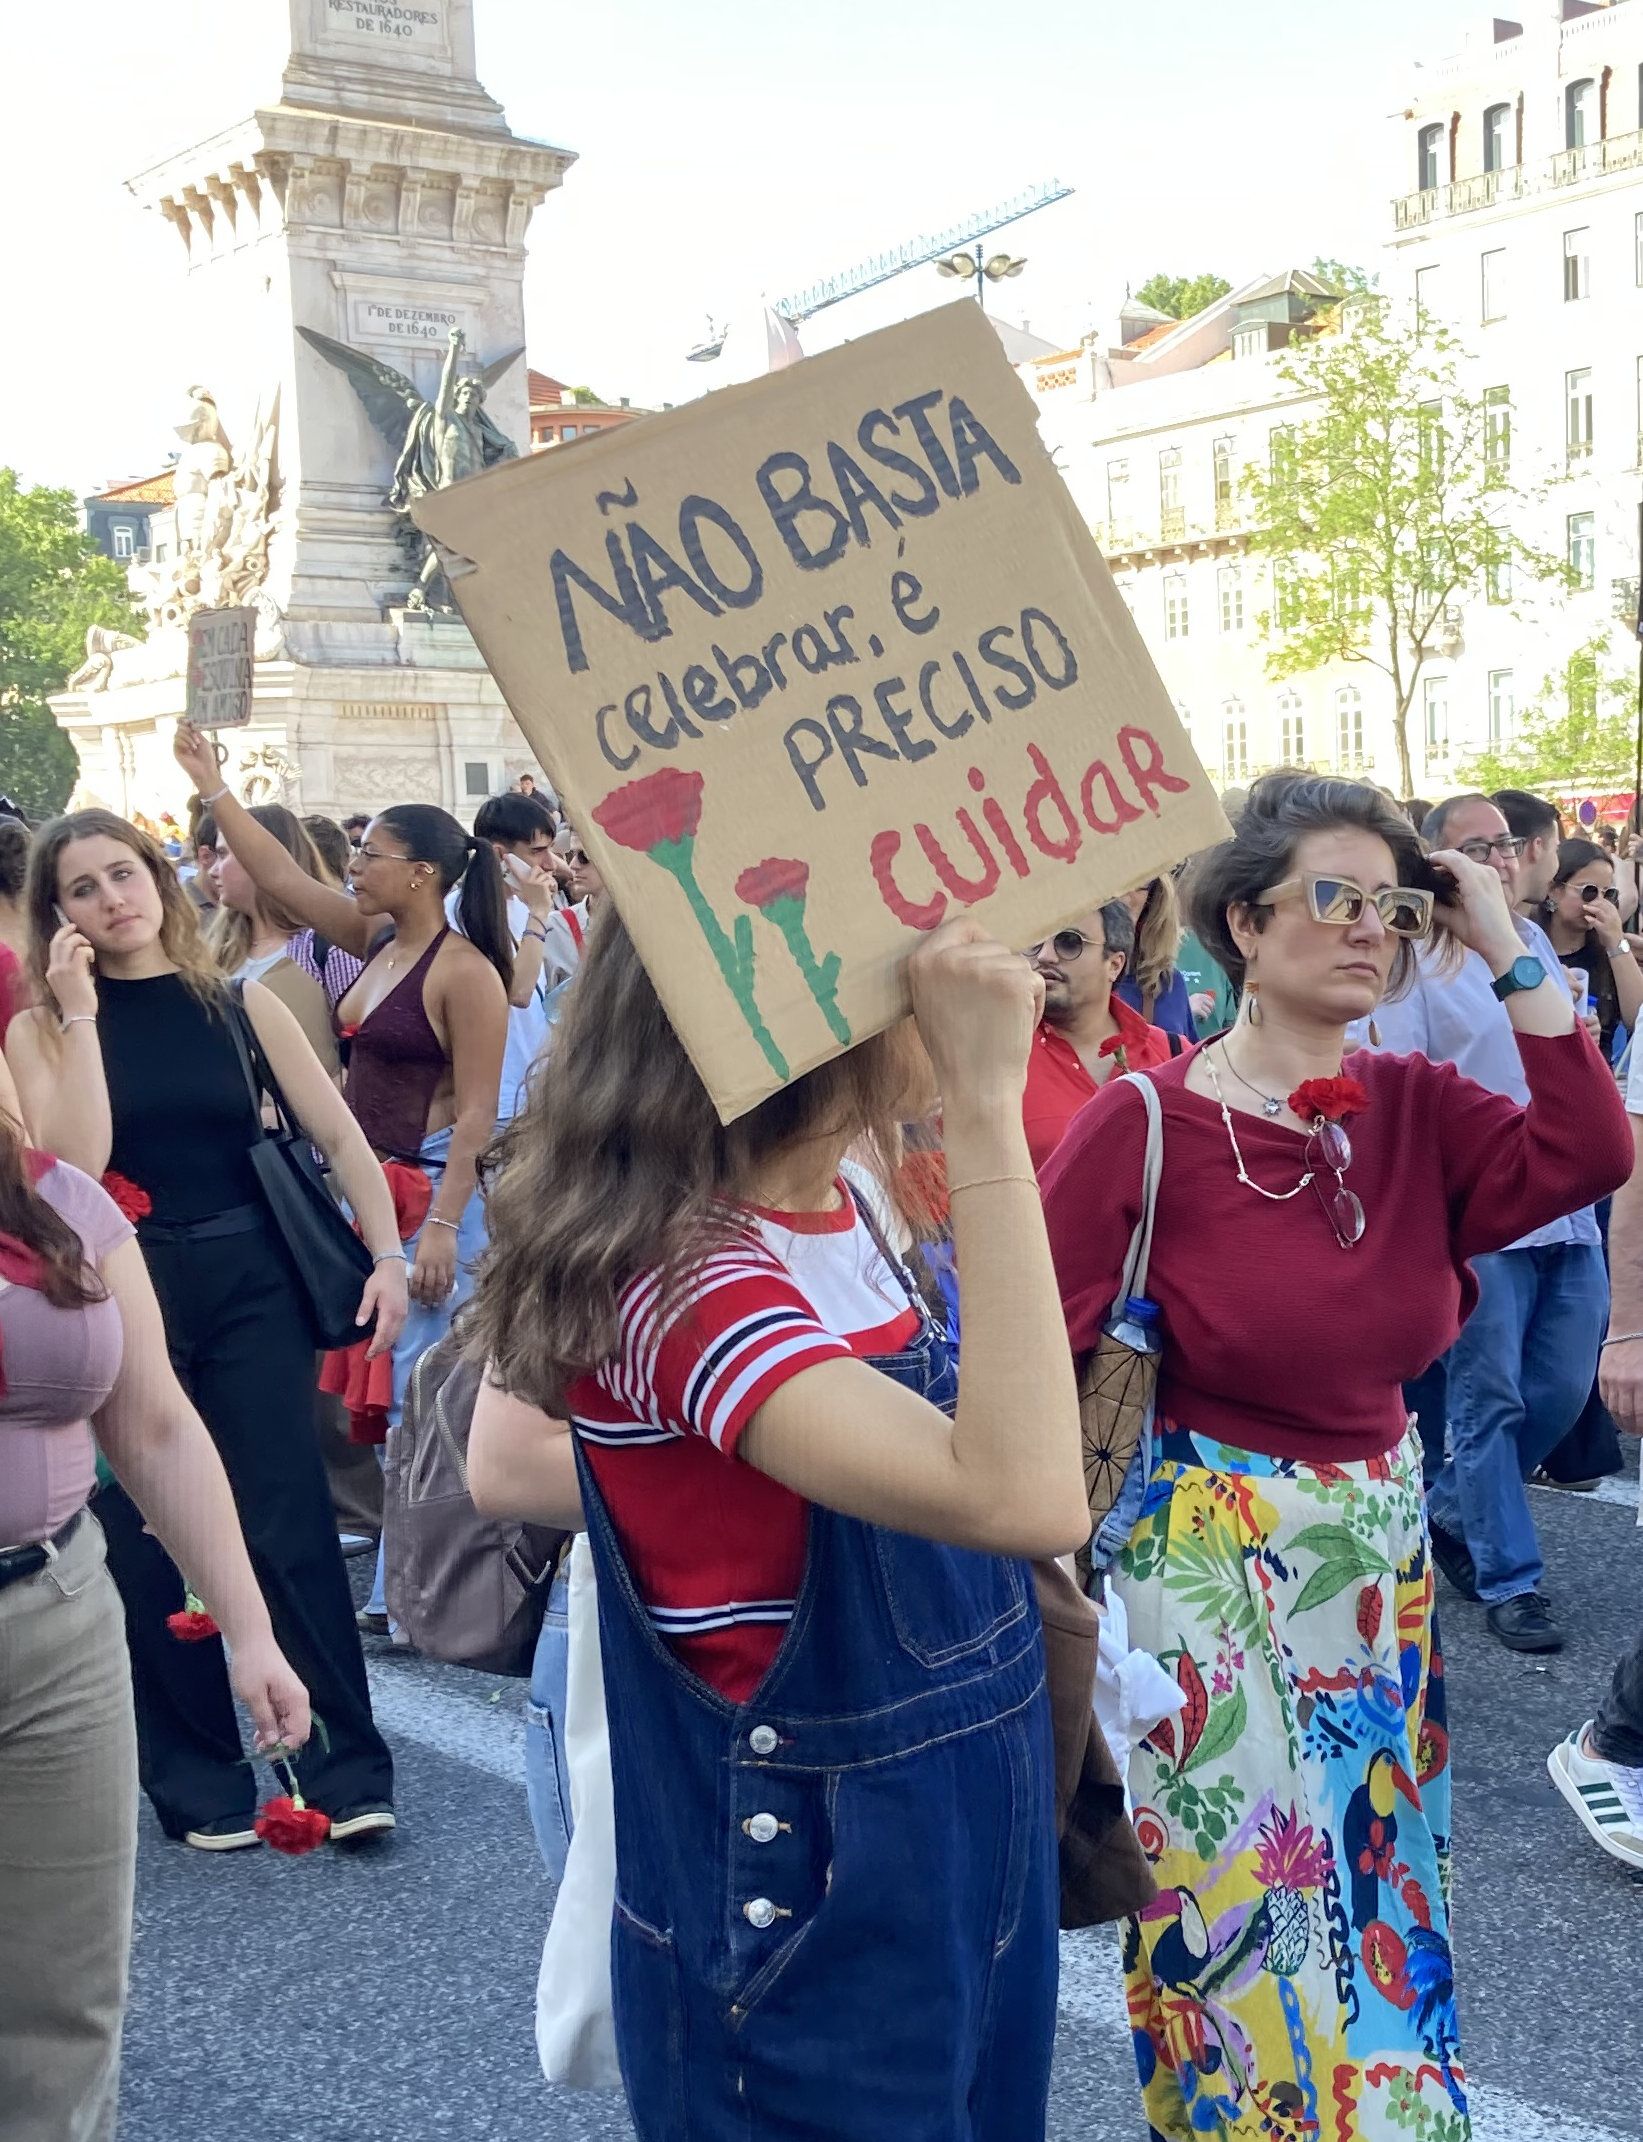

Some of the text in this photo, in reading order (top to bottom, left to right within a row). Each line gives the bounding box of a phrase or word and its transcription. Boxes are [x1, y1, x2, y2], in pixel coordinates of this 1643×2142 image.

[328, 0, 439, 24] RESTAURADORES
[355, 17, 413, 38] DE 1640
[377, 307, 392, 319] DE
[395, 308, 456, 327] DEZEMBRO
[389, 322, 438, 338] DE 1640
[550, 388, 1022, 674] NÃO BASTA
[891, 536, 940, 635] é
[783, 607, 1079, 812] PRECISO
